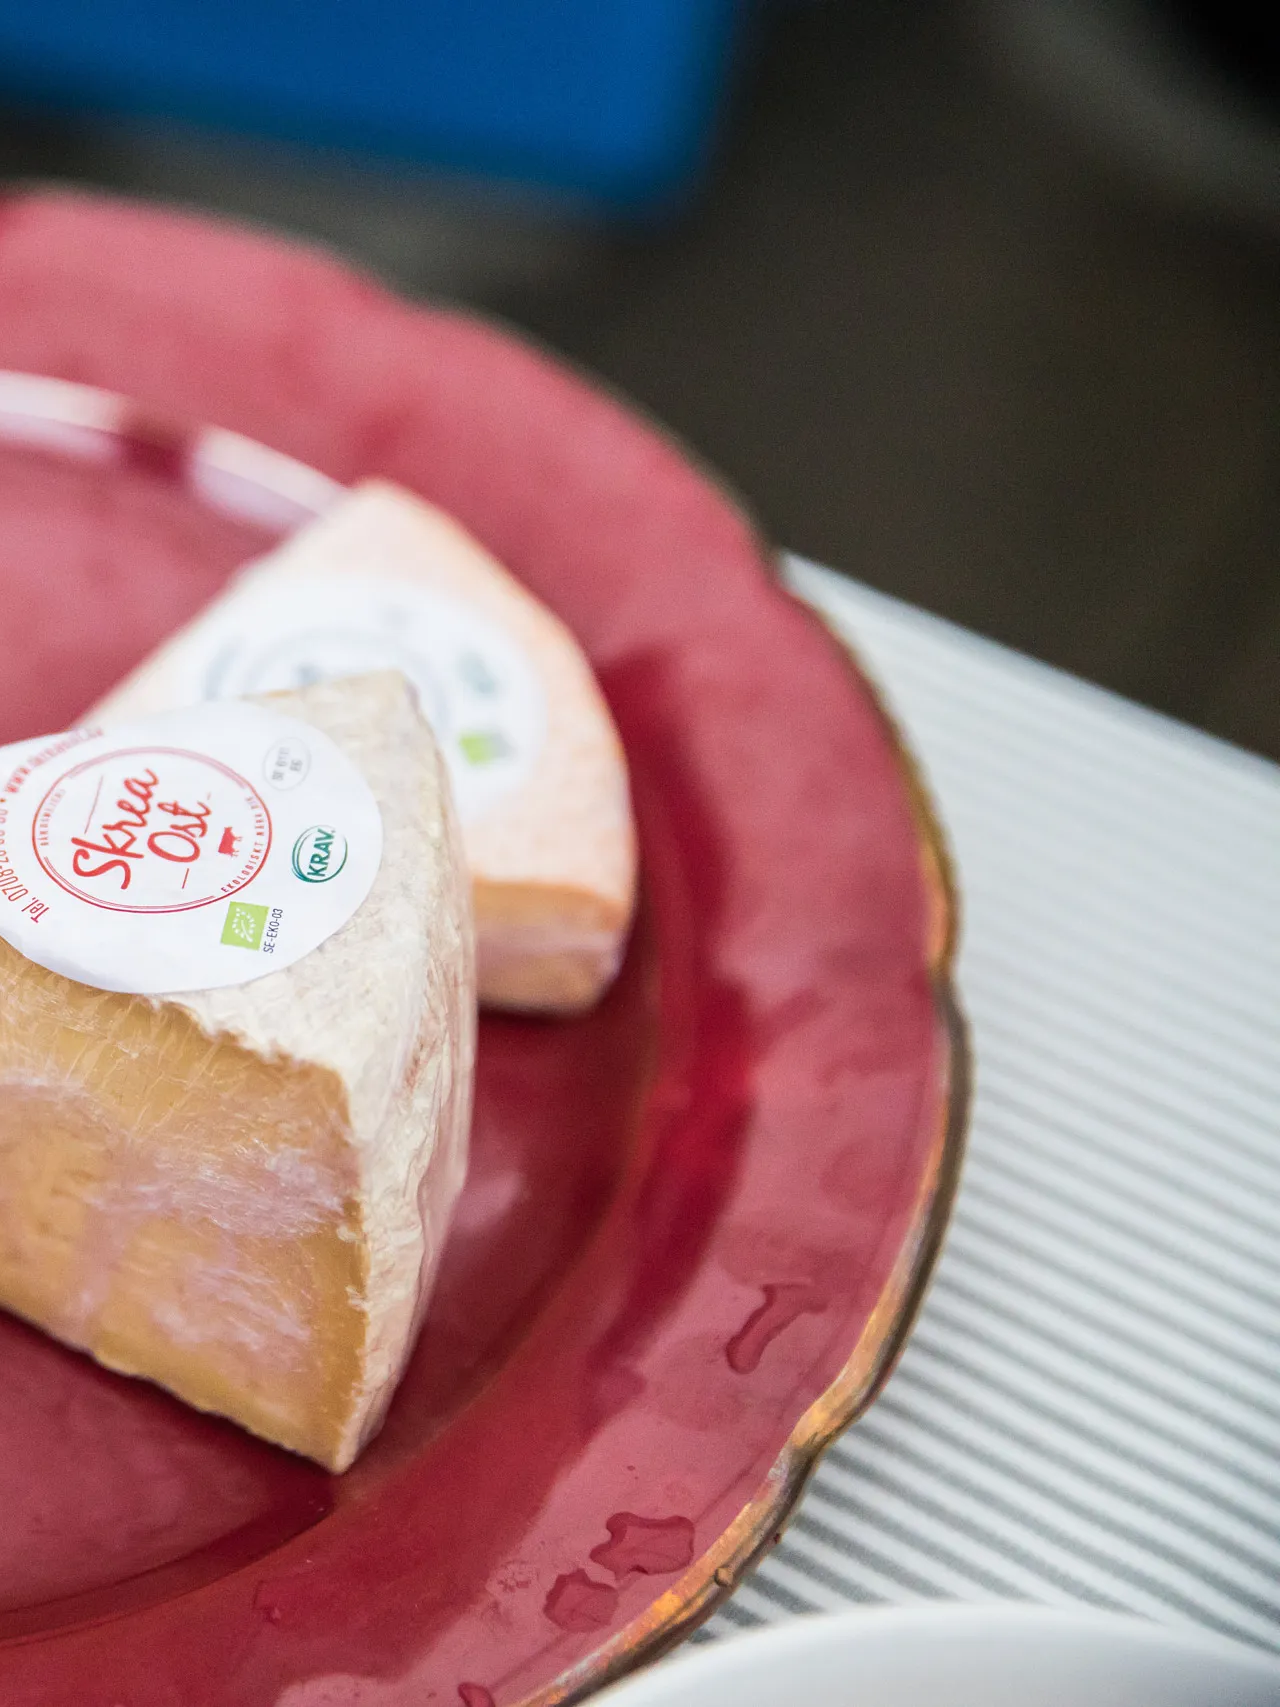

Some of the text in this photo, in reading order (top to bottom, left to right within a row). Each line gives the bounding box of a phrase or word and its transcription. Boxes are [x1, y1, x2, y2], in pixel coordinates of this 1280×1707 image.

[71, 768, 160, 890] Skrea
[147, 801, 211, 863] Ost
[307, 828, 334, 877] KRAV
[220, 841, 264, 893] EKOLOGISKT
[21, 896, 50, 924] Tel.
[263, 908, 283, 953] SE-EKO-03
